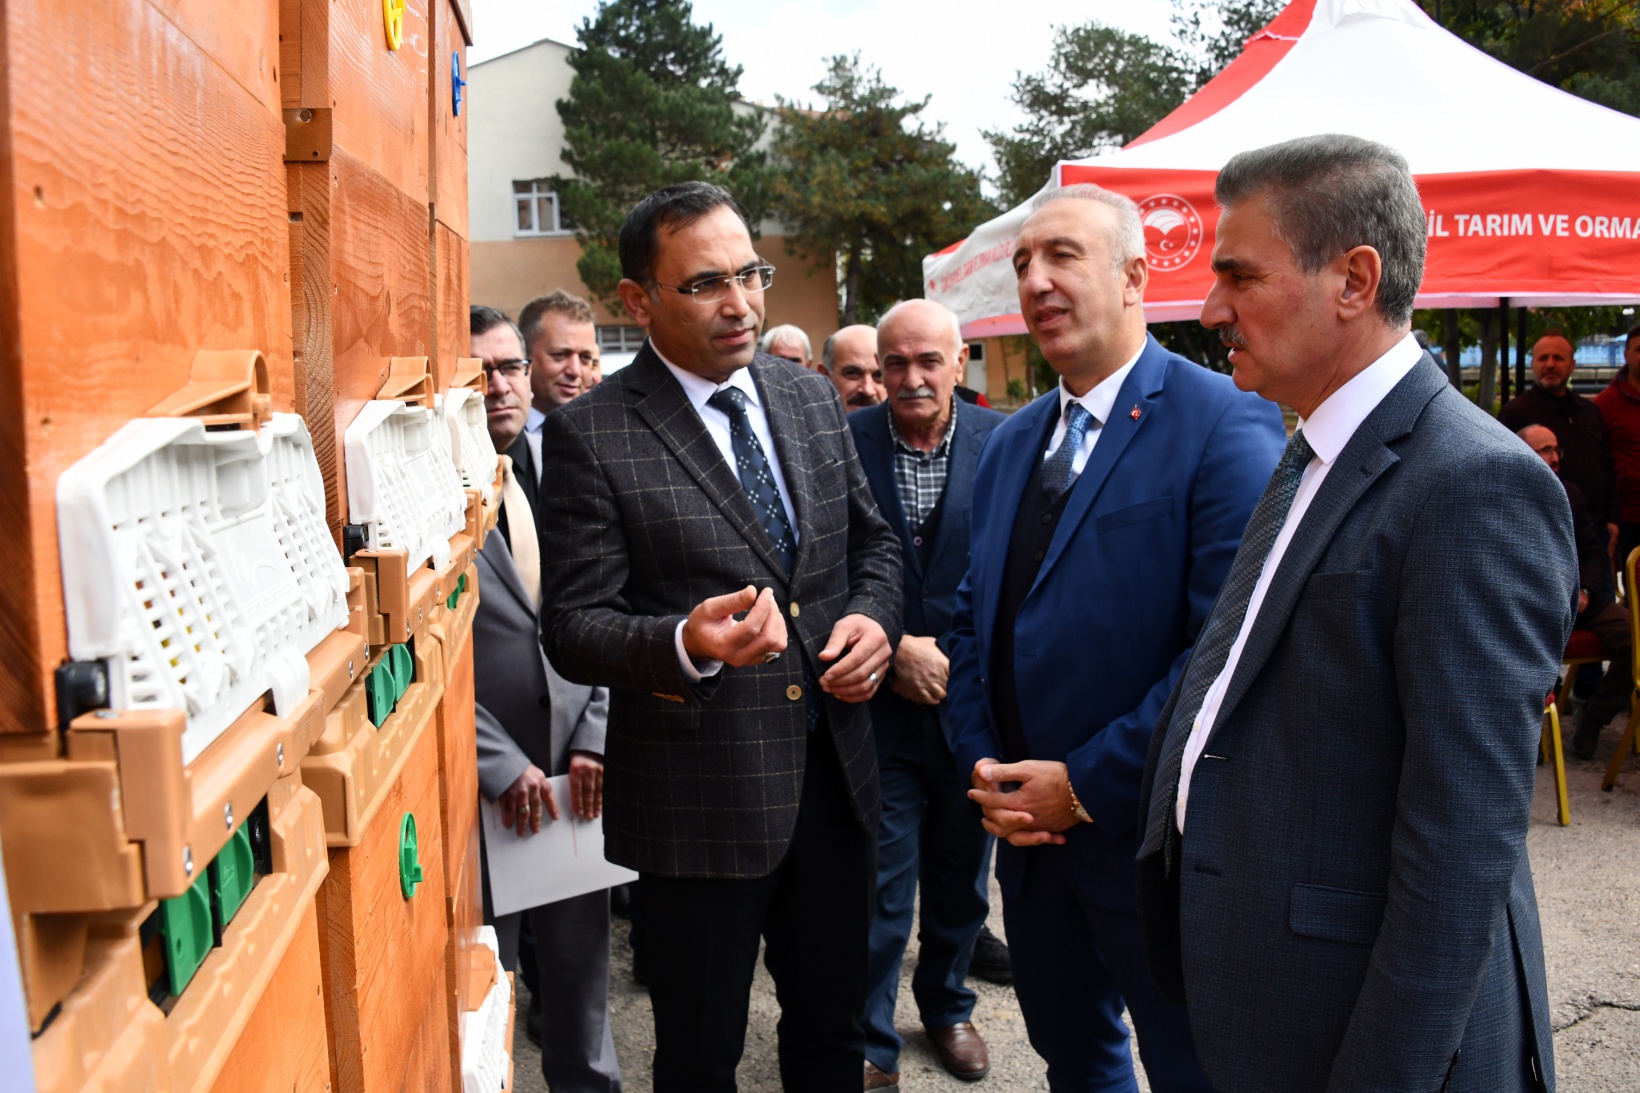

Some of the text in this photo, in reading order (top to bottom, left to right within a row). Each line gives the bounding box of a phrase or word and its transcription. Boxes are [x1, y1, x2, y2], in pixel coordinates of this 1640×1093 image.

[1428, 209, 1450, 237] İL
[1454, 214, 1533, 237] TARIM
[1537, 214, 1570, 237] VE
